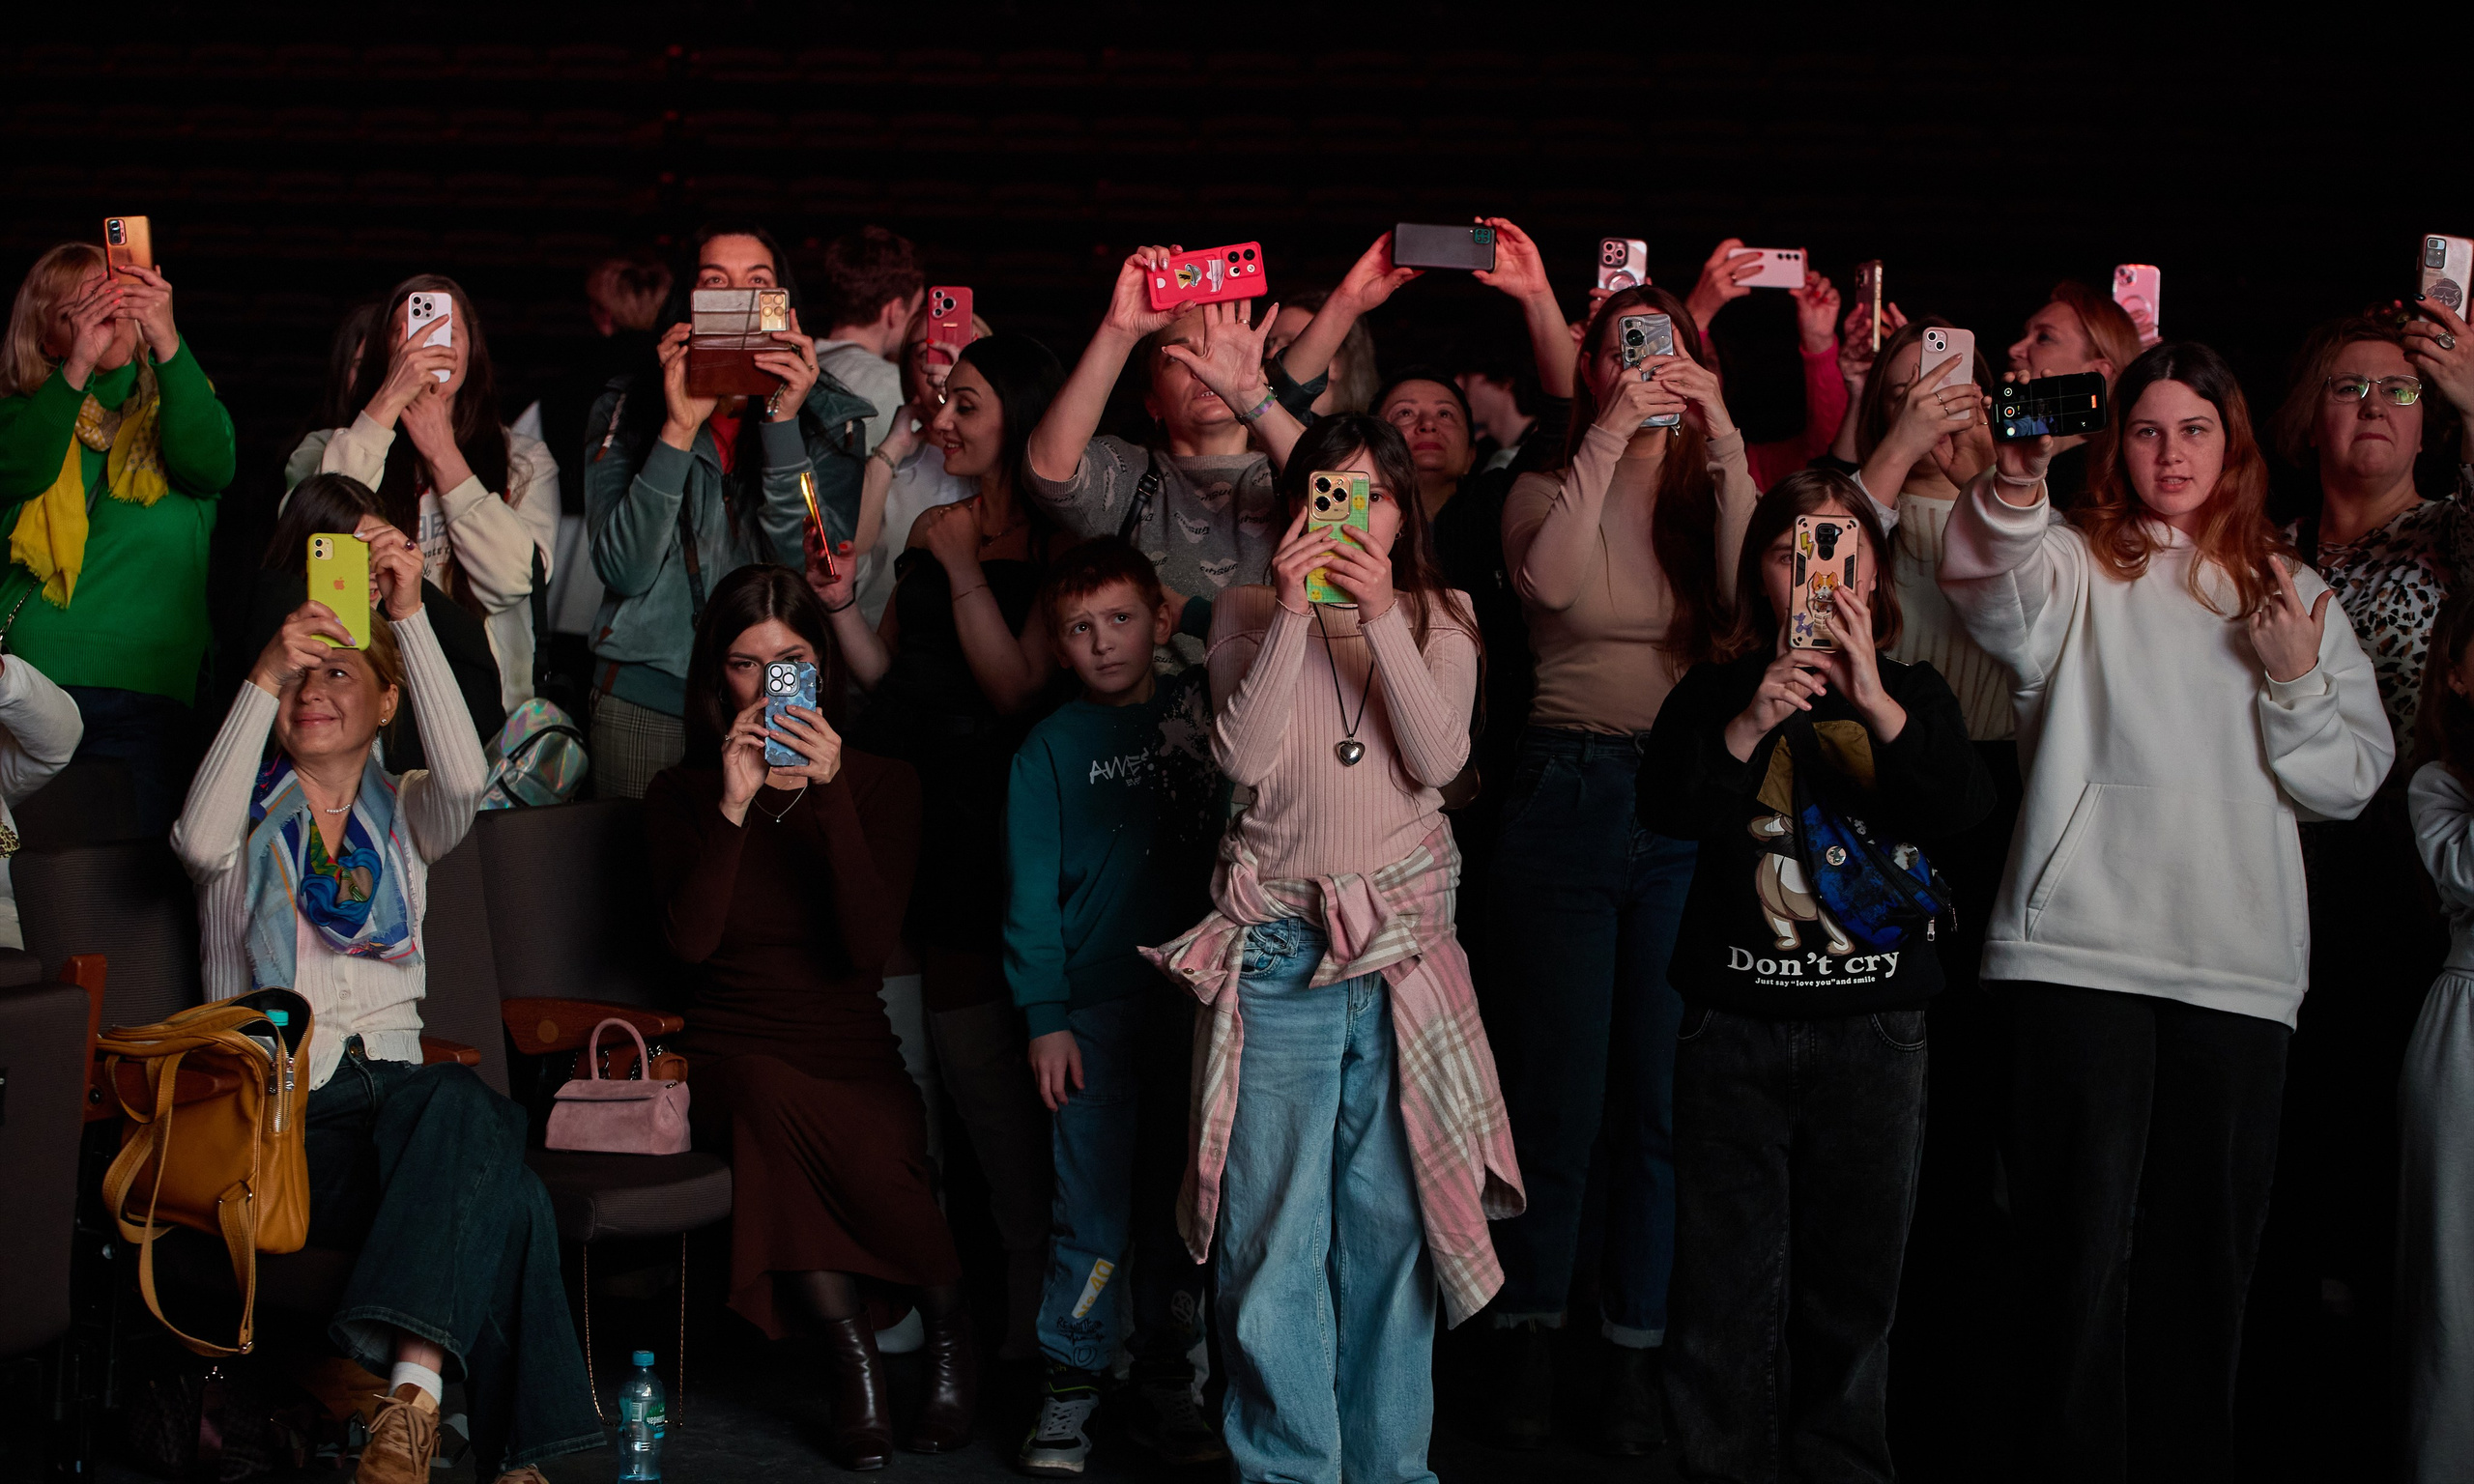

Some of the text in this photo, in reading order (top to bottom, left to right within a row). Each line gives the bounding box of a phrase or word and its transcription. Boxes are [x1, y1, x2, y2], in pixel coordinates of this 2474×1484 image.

[1727, 945, 1900, 979] Don’t cry
[1755, 977, 1774, 985] Just
[1090, 1260, 1113, 1292] 40
